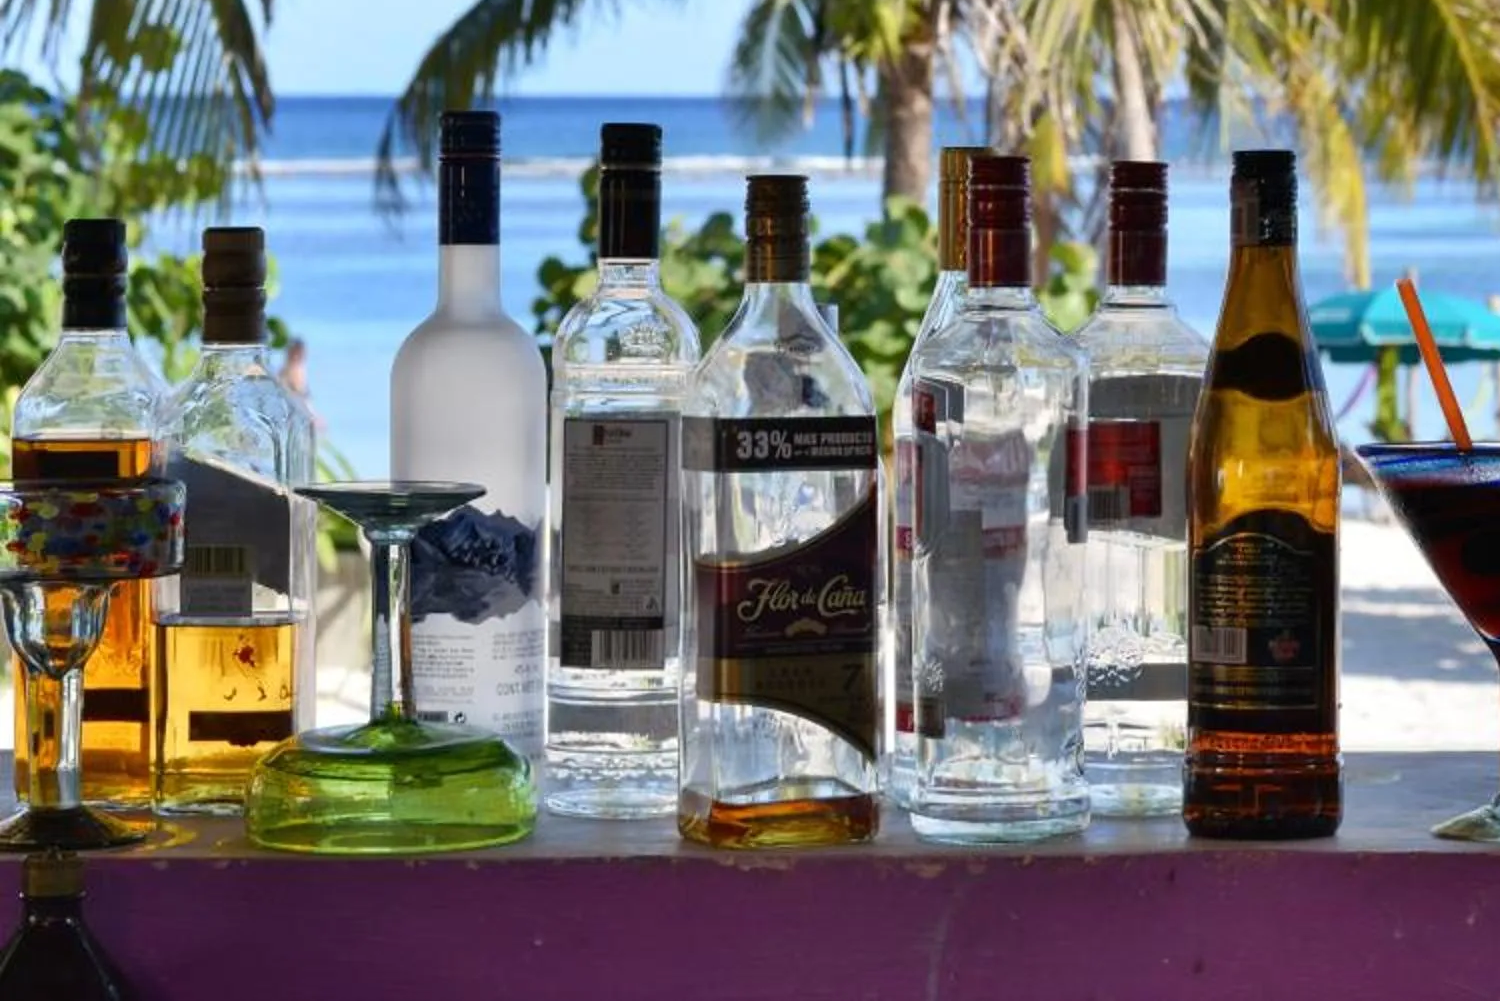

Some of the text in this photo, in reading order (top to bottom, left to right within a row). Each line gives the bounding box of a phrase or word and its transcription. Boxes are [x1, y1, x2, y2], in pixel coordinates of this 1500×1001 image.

[735, 429, 793, 459] 33%
[736, 575, 867, 621] Flor de Caña
[840, 662, 865, 692] 7
